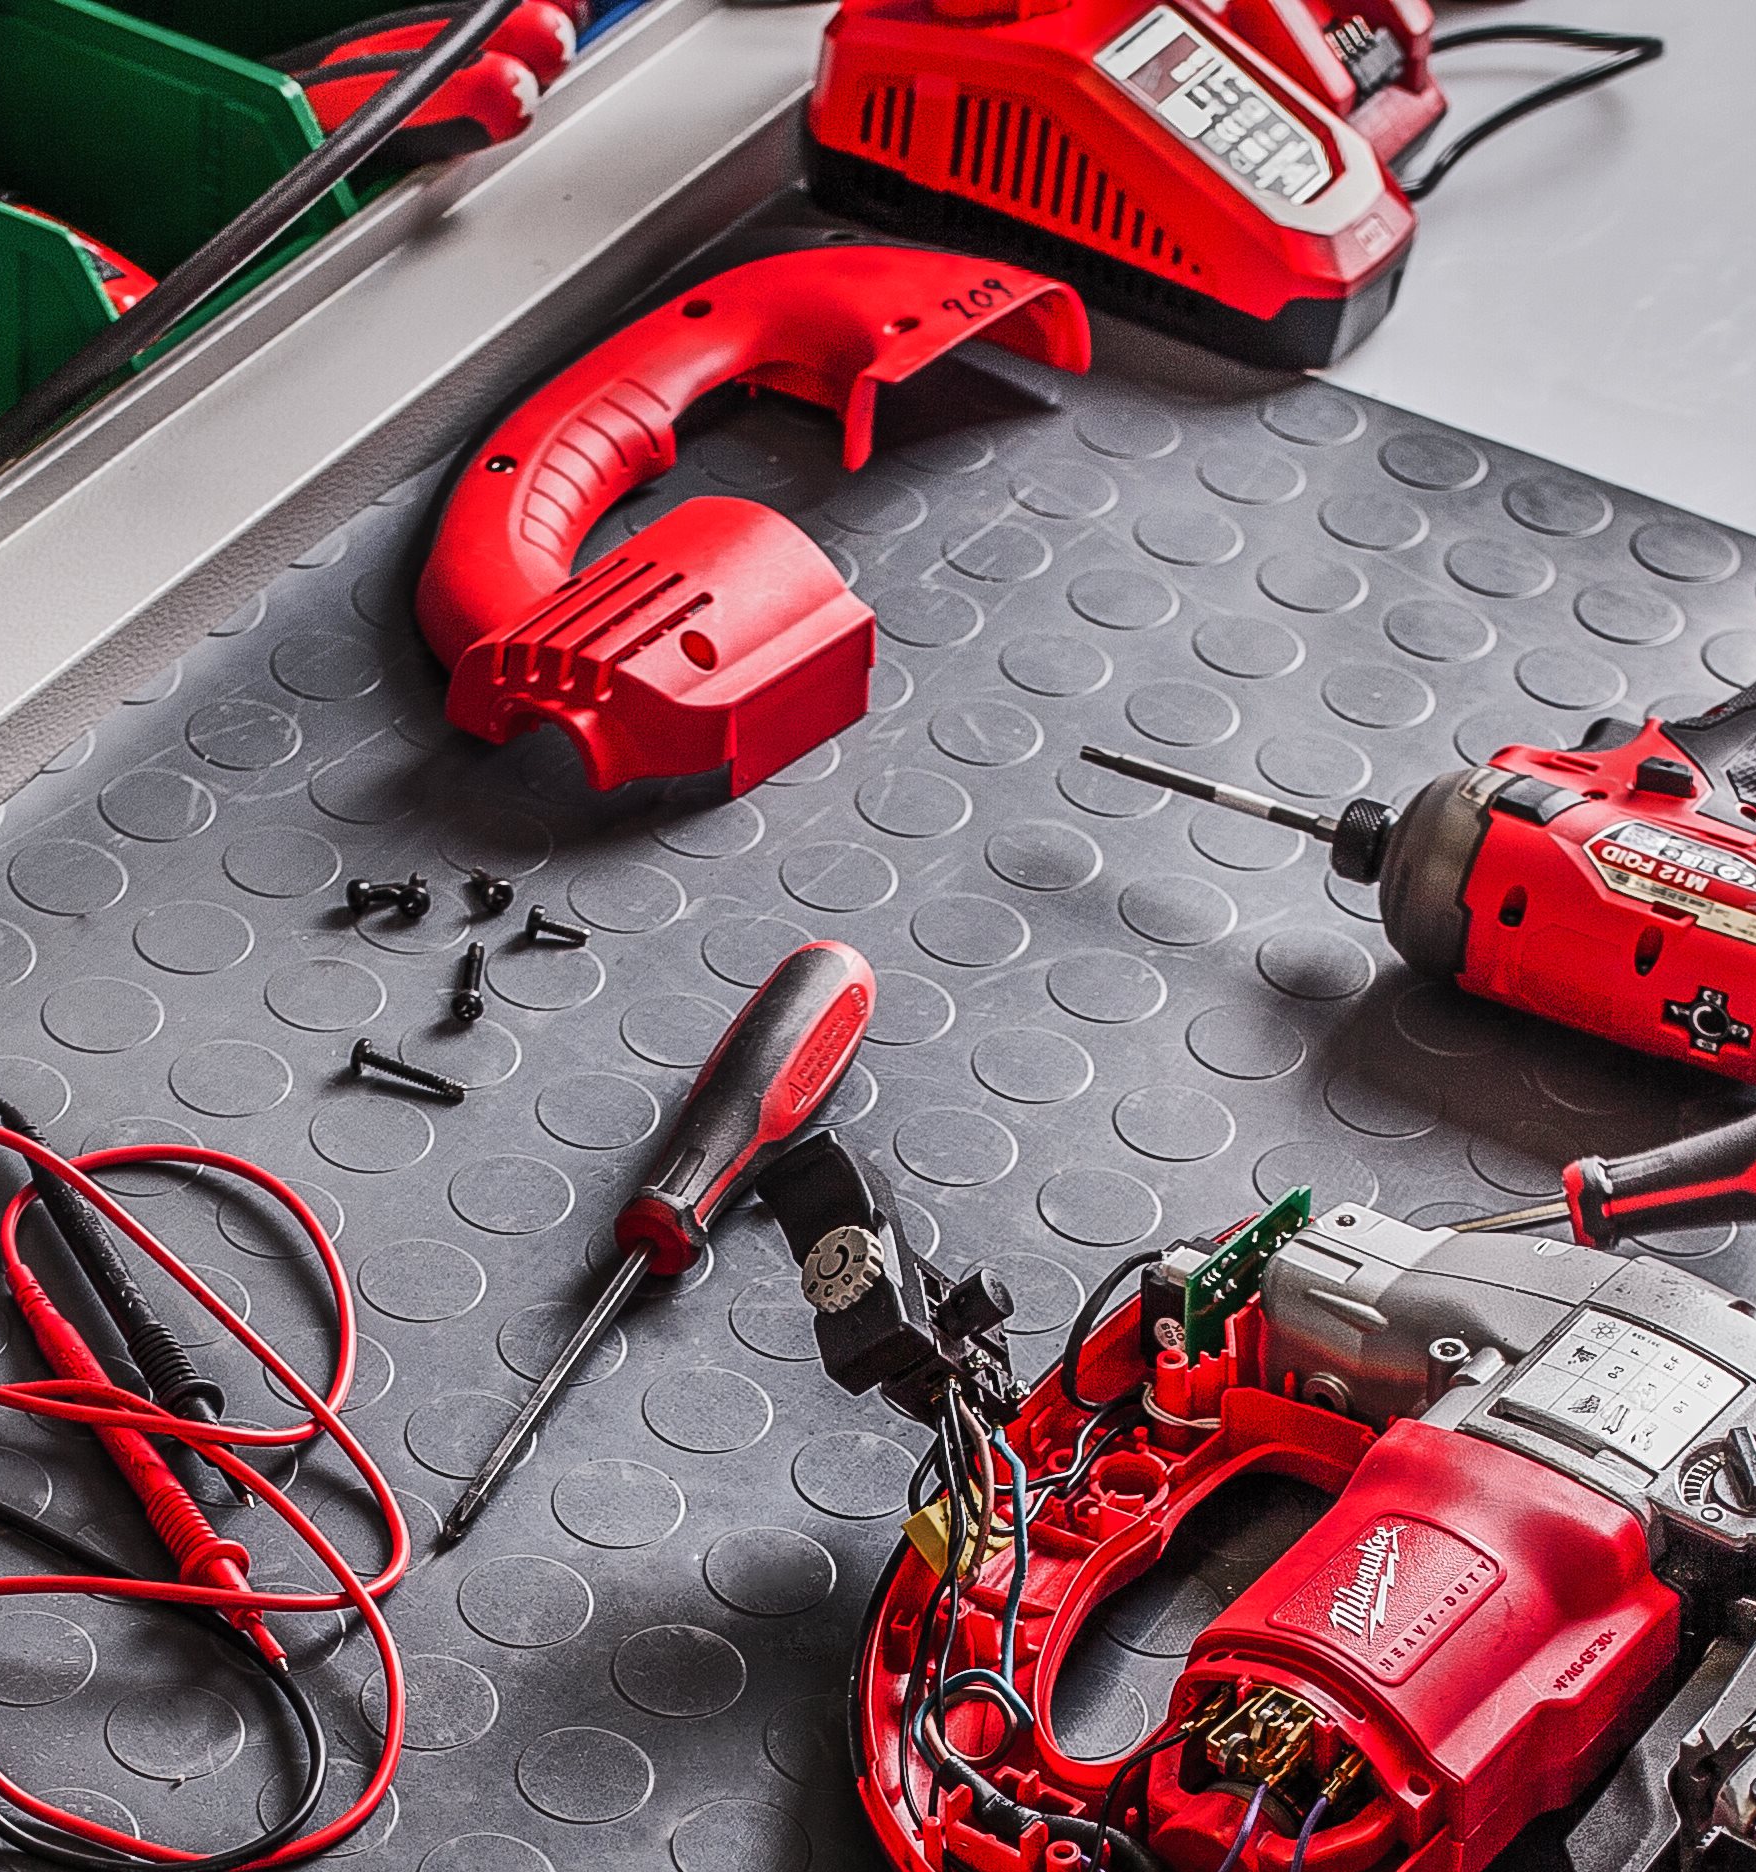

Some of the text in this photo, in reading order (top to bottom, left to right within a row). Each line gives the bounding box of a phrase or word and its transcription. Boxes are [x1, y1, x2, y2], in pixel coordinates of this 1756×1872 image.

[943, 278, 1013, 320] 209
[1601, 844, 1658, 876] FQID
[1657, 864, 1711, 893] M12
[852, 1253, 867, 1264] E
[806, 1280, 819, 1295] B
[823, 1283, 834, 1298] C
[841, 1273, 854, 1286] D
[1328, 1525, 1397, 1638] Milwaukee
